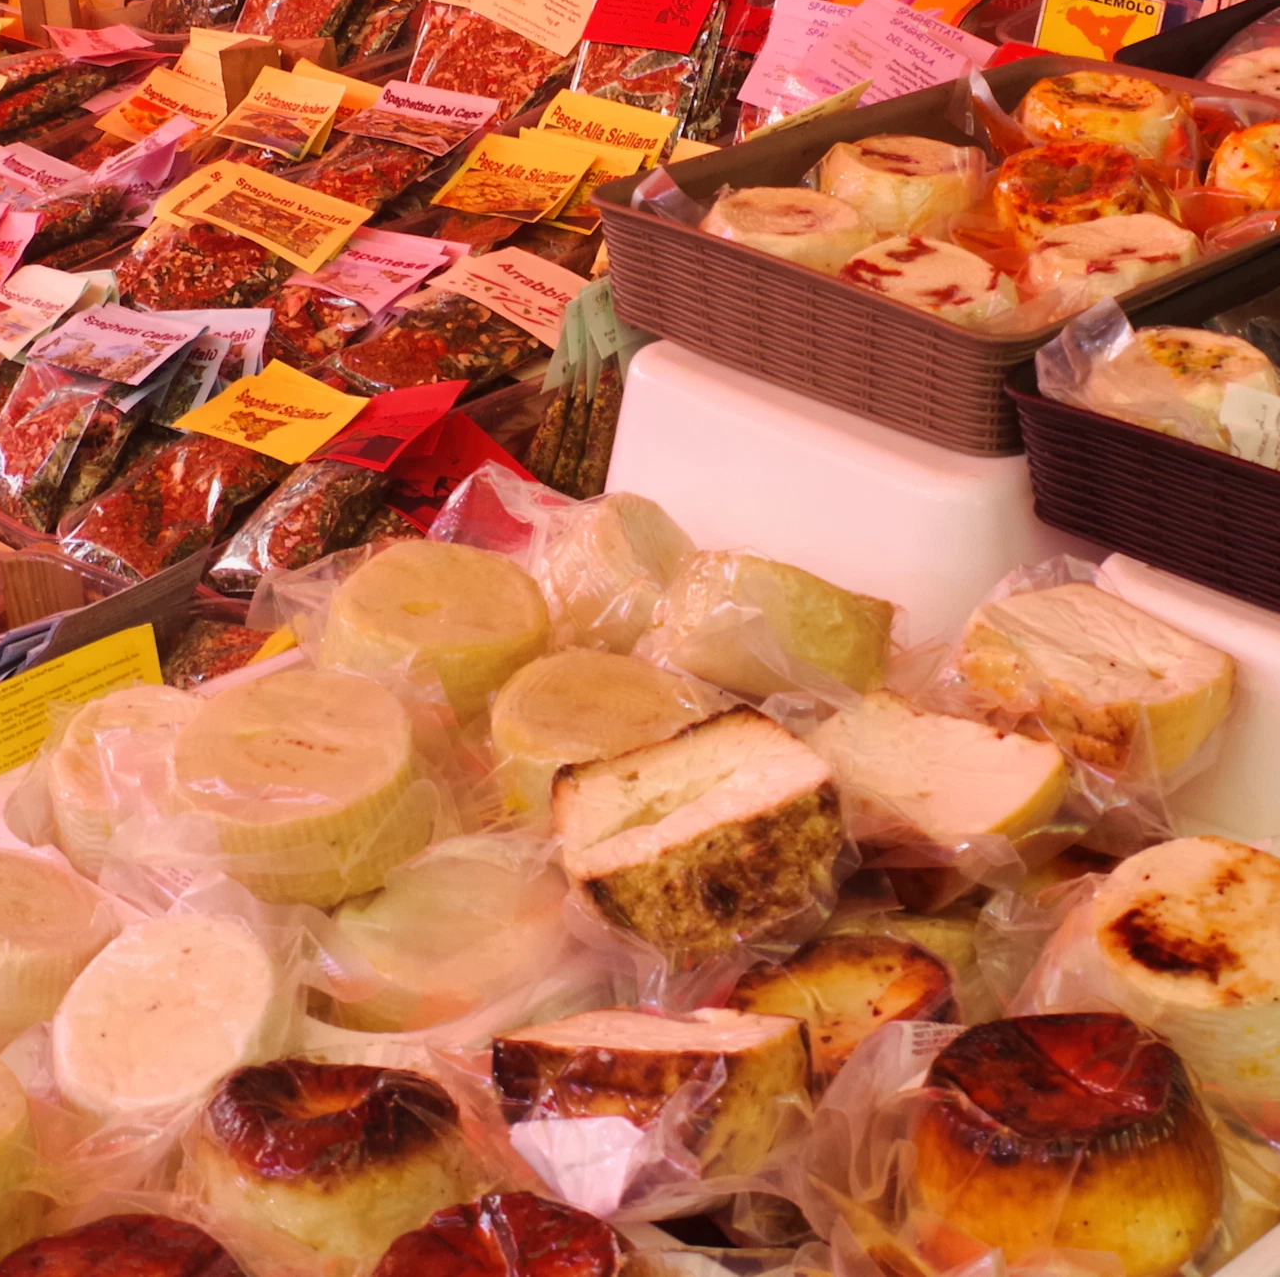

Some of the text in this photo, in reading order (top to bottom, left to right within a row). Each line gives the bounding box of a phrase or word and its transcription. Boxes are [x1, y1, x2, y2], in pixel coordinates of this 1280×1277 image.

[890, 18, 955, 60] SPAGHETTATA
[896, 7, 964, 42] SPAGHETTATA
[383, 90, 483, 120] Spaghettata Del Capo
[551, 105, 658, 150] Pesce Alla Siciliana
[475, 151, 575, 184] Pesce Alla Siciliana
[236, 176, 351, 226] Spaghetti Vucciria
[83, 315, 141, 336] Spaghetti
